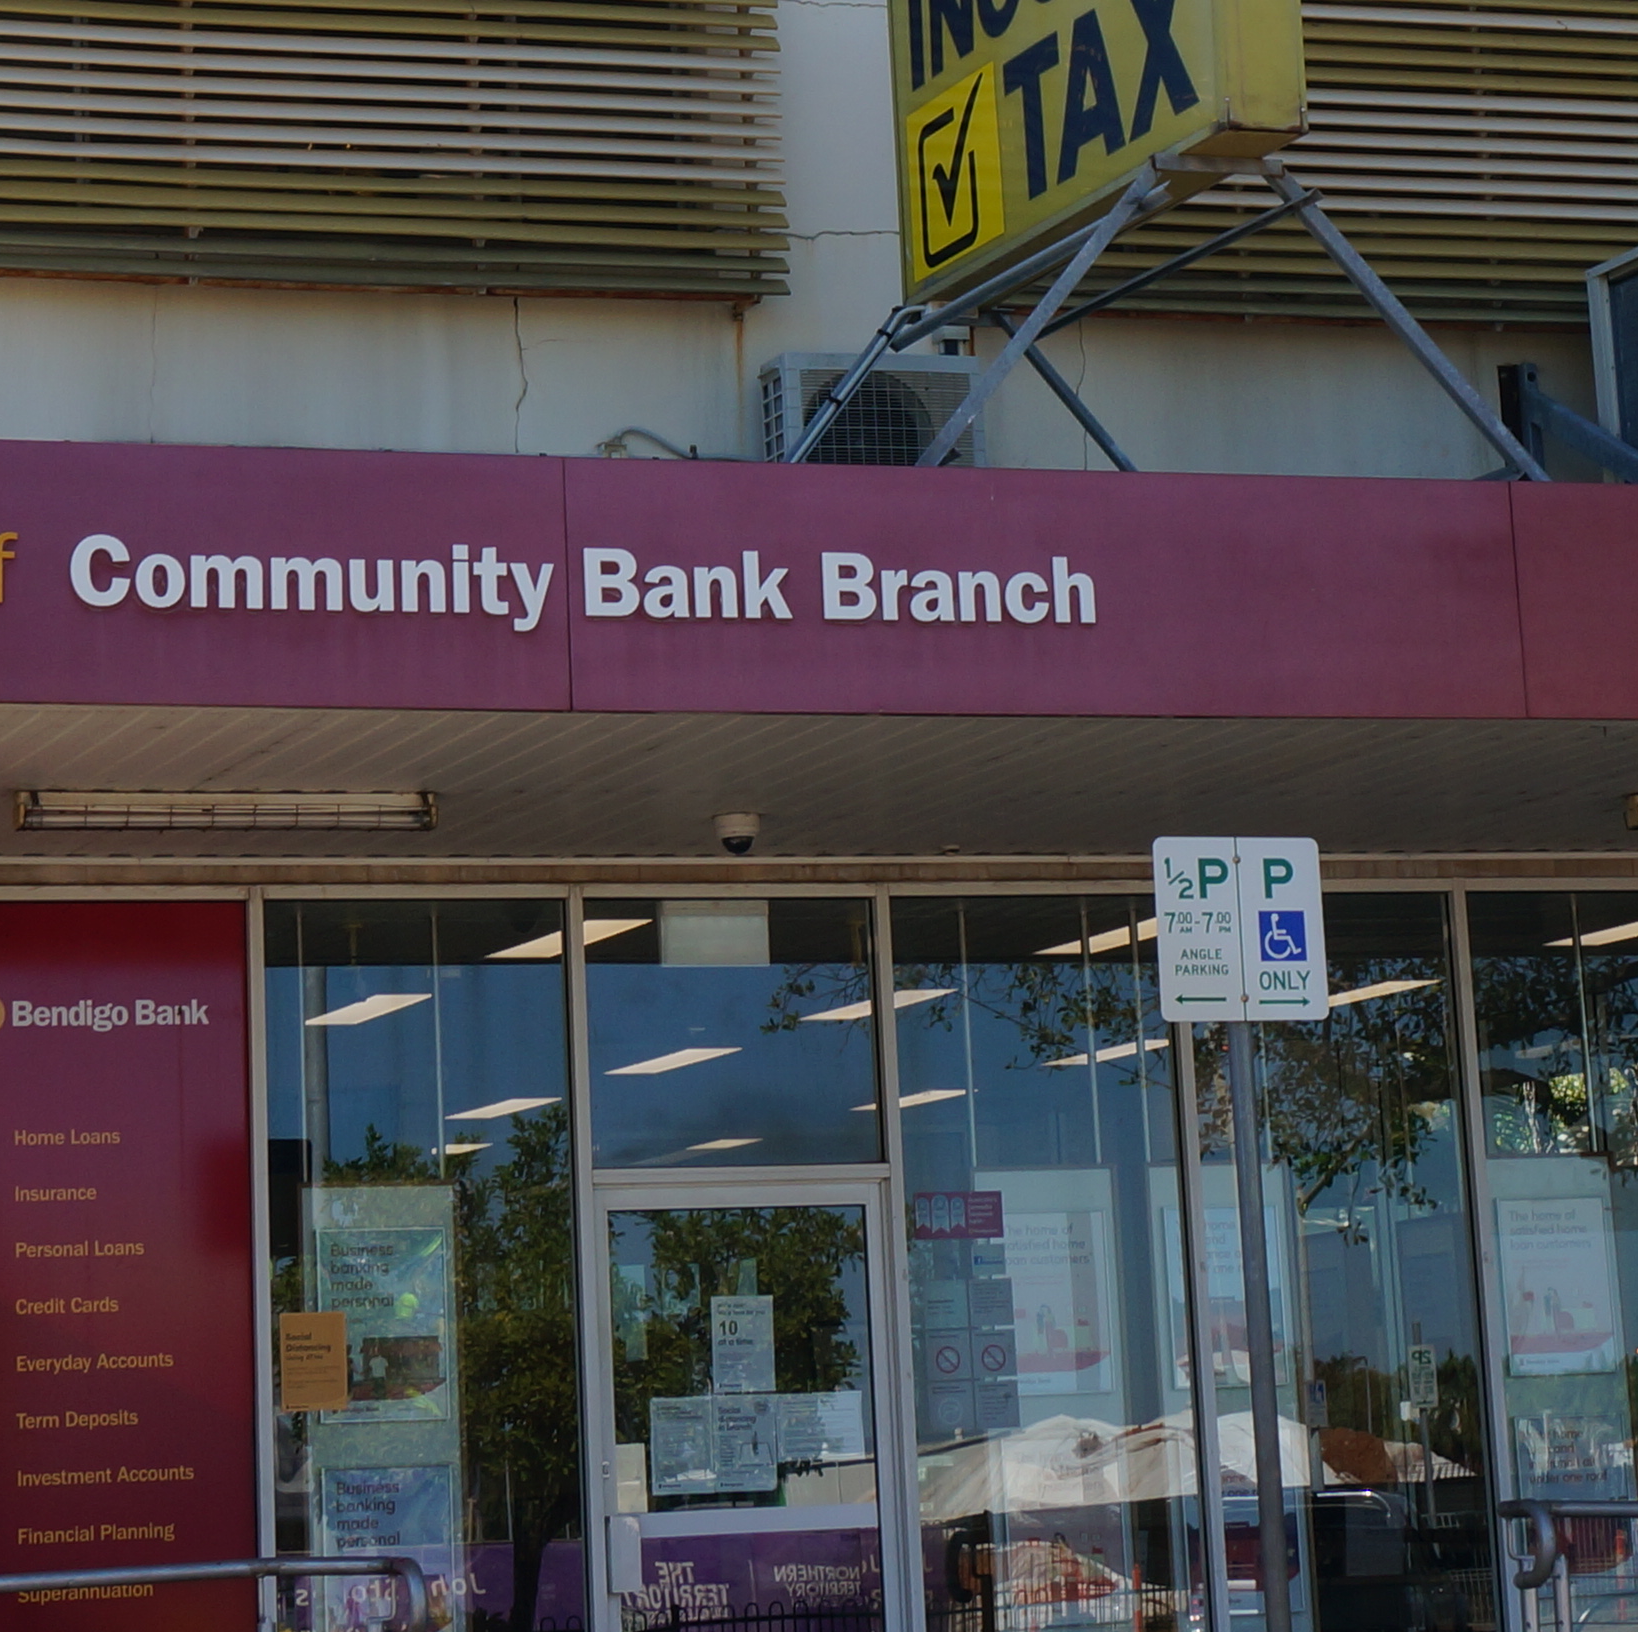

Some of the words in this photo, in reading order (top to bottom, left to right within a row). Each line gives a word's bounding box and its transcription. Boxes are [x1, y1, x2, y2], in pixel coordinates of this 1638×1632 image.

[69, 533, 555, 633] Community
[582, 546, 794, 620] Bank
[820, 551, 1098, 625] Branch
[1262, 857, 1294, 899] P
[1180, 948, 1223, 961] ANGLE
[1174, 963, 1230, 977] PARKING
[1258, 969, 1311, 991] ONLY
[11, 998, 129, 1033] Bendigo
[134, 998, 209, 1027] Bank
[13, 1129, 66, 1147] Home
[70, 1127, 121, 1145] Loans
[14, 1185, 97, 1202] Insurance
[15, 1241, 90, 1259] Personal
[94, 1240, 145, 1257] Loans
[330, 1242, 394, 1258] Business
[330, 1276, 374, 1292] made
[15, 1297, 66, 1316] Credit
[71, 1296, 120, 1314] Cards
[331, 1293, 395, 1311] personal
[718, 1319, 739, 1337] 10
[16, 1354, 92, 1375] Everyday
[96, 1352, 174, 1370] Accounts
[16, 1412, 60, 1430] Term
[65, 1409, 139, 1431] Deposits
[17, 1468, 112, 1488] Investment
[117, 1465, 195, 1484] Accounts
[335, 1480, 401, 1496] Business
[335, 1497, 397, 1515] banking
[336, 1516, 380, 1531] made
[17, 1525, 95, 1546] Financial
[100, 1521, 176, 1542] Planning
